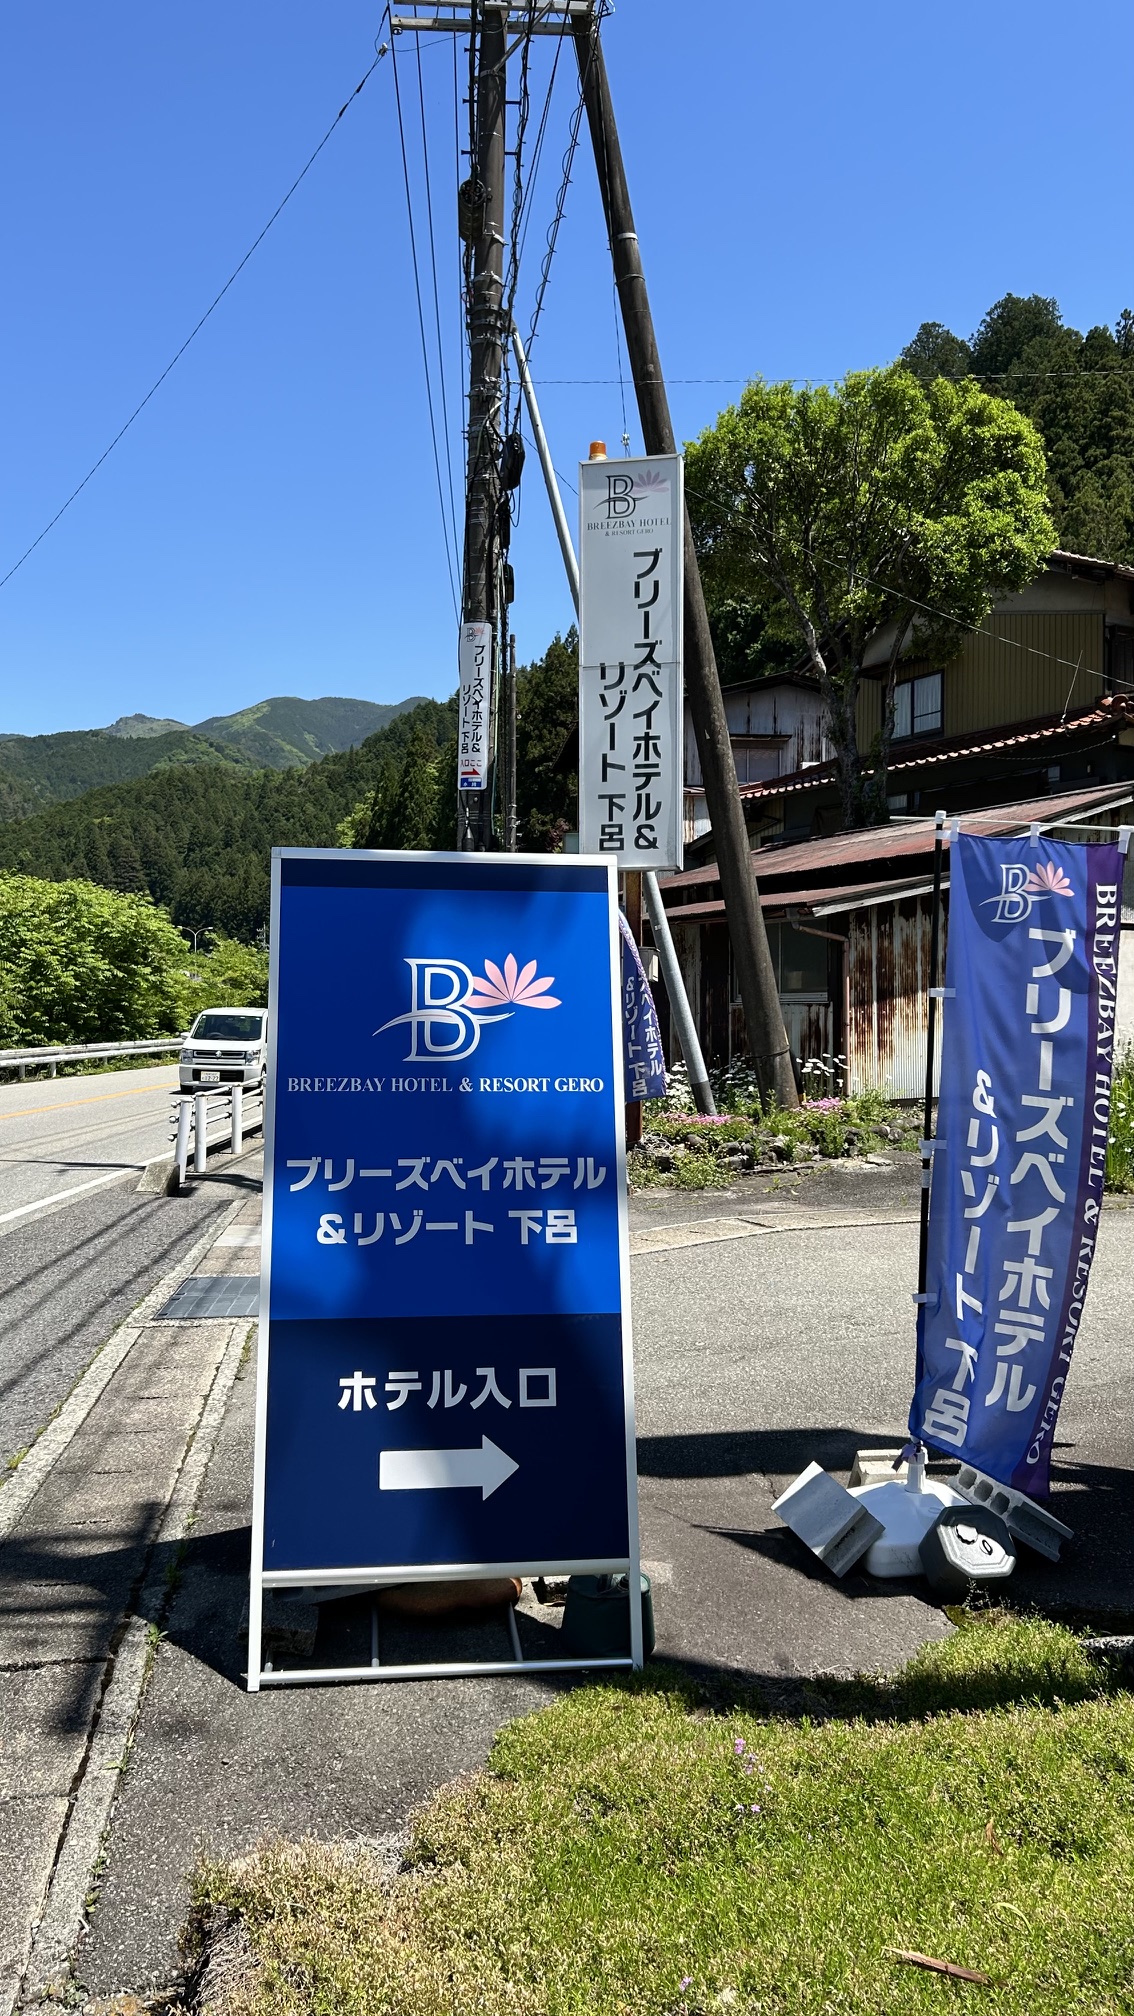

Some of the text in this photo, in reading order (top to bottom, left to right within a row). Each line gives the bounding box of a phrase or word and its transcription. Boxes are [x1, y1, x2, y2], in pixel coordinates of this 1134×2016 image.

[587, 517, 671, 531] BREEZBAY HOTEL
[637, 527, 654, 535] GERO
[598, 661, 627, 851] リゾート 下呂
[1092, 882, 1117, 1064] BREEZBAY
[287, 1077, 604, 1093] BREEZBAY HOTEL & RESORT GERO
[1087, 1071, 1111, 1187] HOTEL
[286, 1156, 606, 1193] ブリーズベイホテル
[985, 927, 1076, 1412] ブリーズベイホテル
[316, 1209, 578, 1246] &リゾート 下呂
[1083, 1198, 1100, 1225] &
[338, 1367, 557, 1411] ホテル入口
[921, 1337, 979, 1448] 下呂
